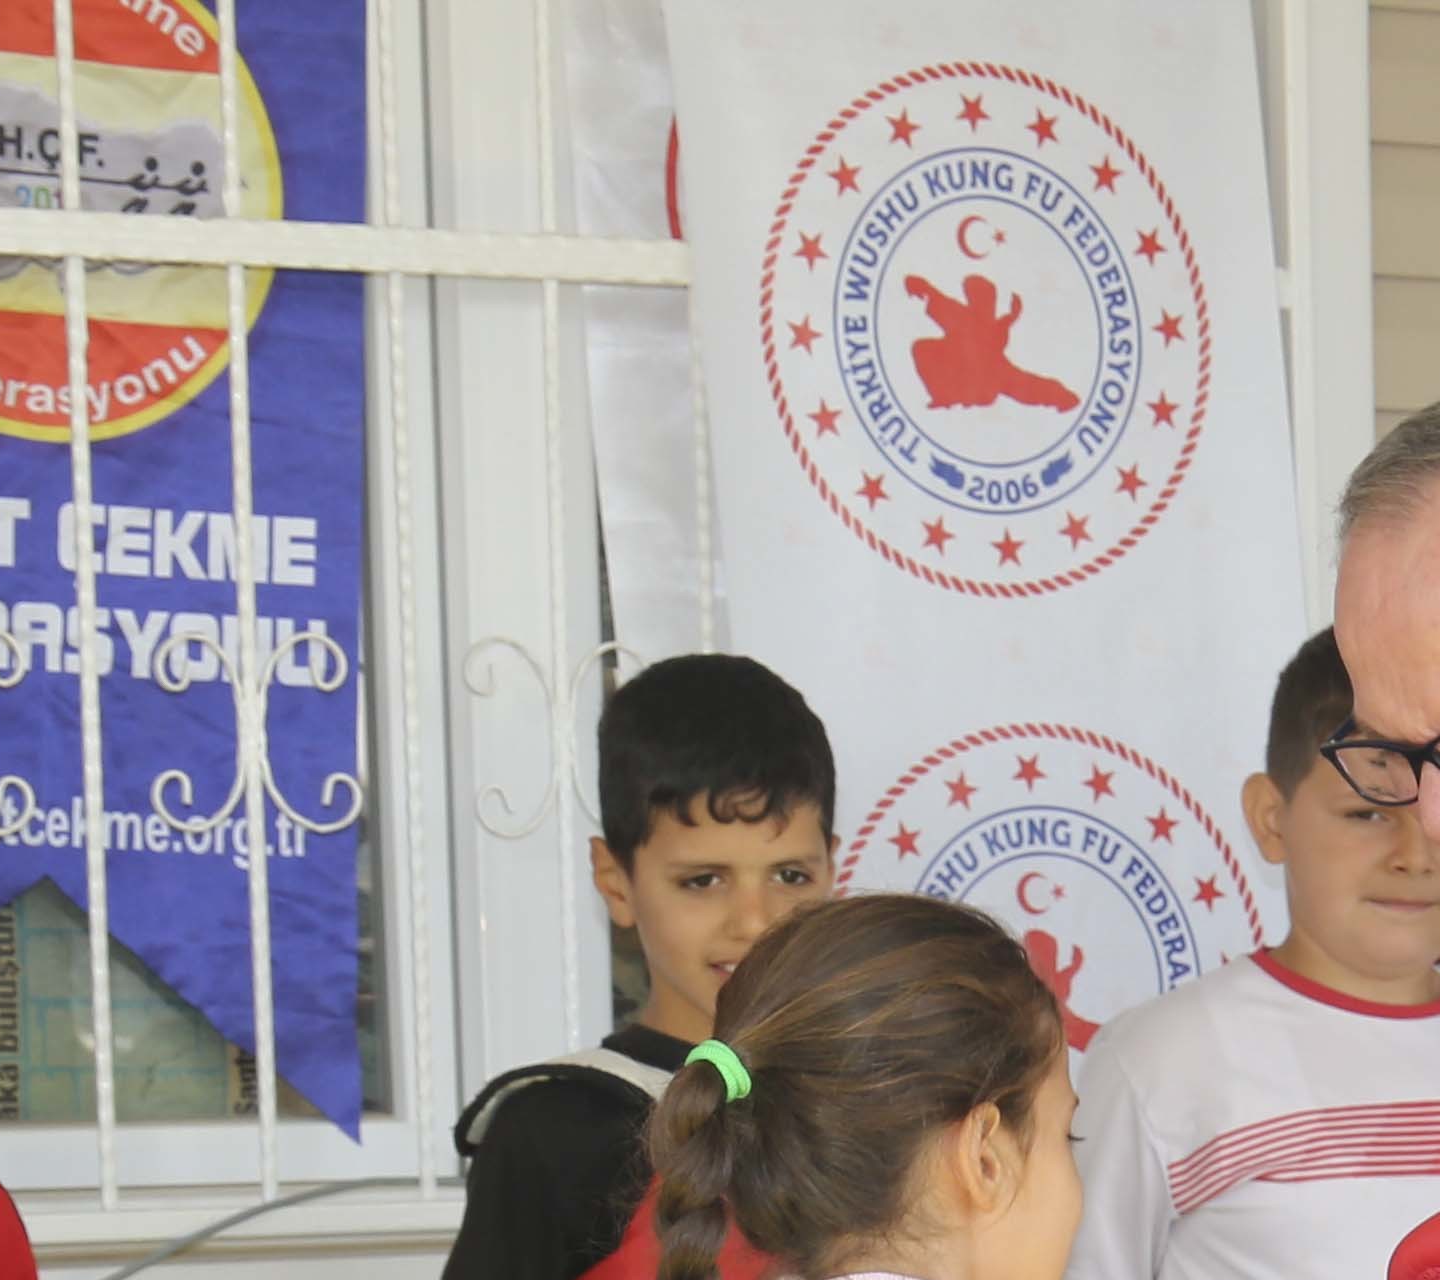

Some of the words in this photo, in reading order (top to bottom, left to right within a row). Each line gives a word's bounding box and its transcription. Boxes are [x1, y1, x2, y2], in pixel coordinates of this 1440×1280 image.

[922, 159, 1016, 199] KUNG
[1023, 172, 1064, 213] FU
[844, 182, 920, 302] WUSHU
[844, 314, 921, 464] TÜRKİYE
[1063, 205, 1133, 456] FEDERASYONU
[966, 474, 1040, 505] 2006
[981, 817, 1072, 857] KUNG
[1081, 825, 1121, 865] FU
[1121, 855, 1192, 990] FEDERA
